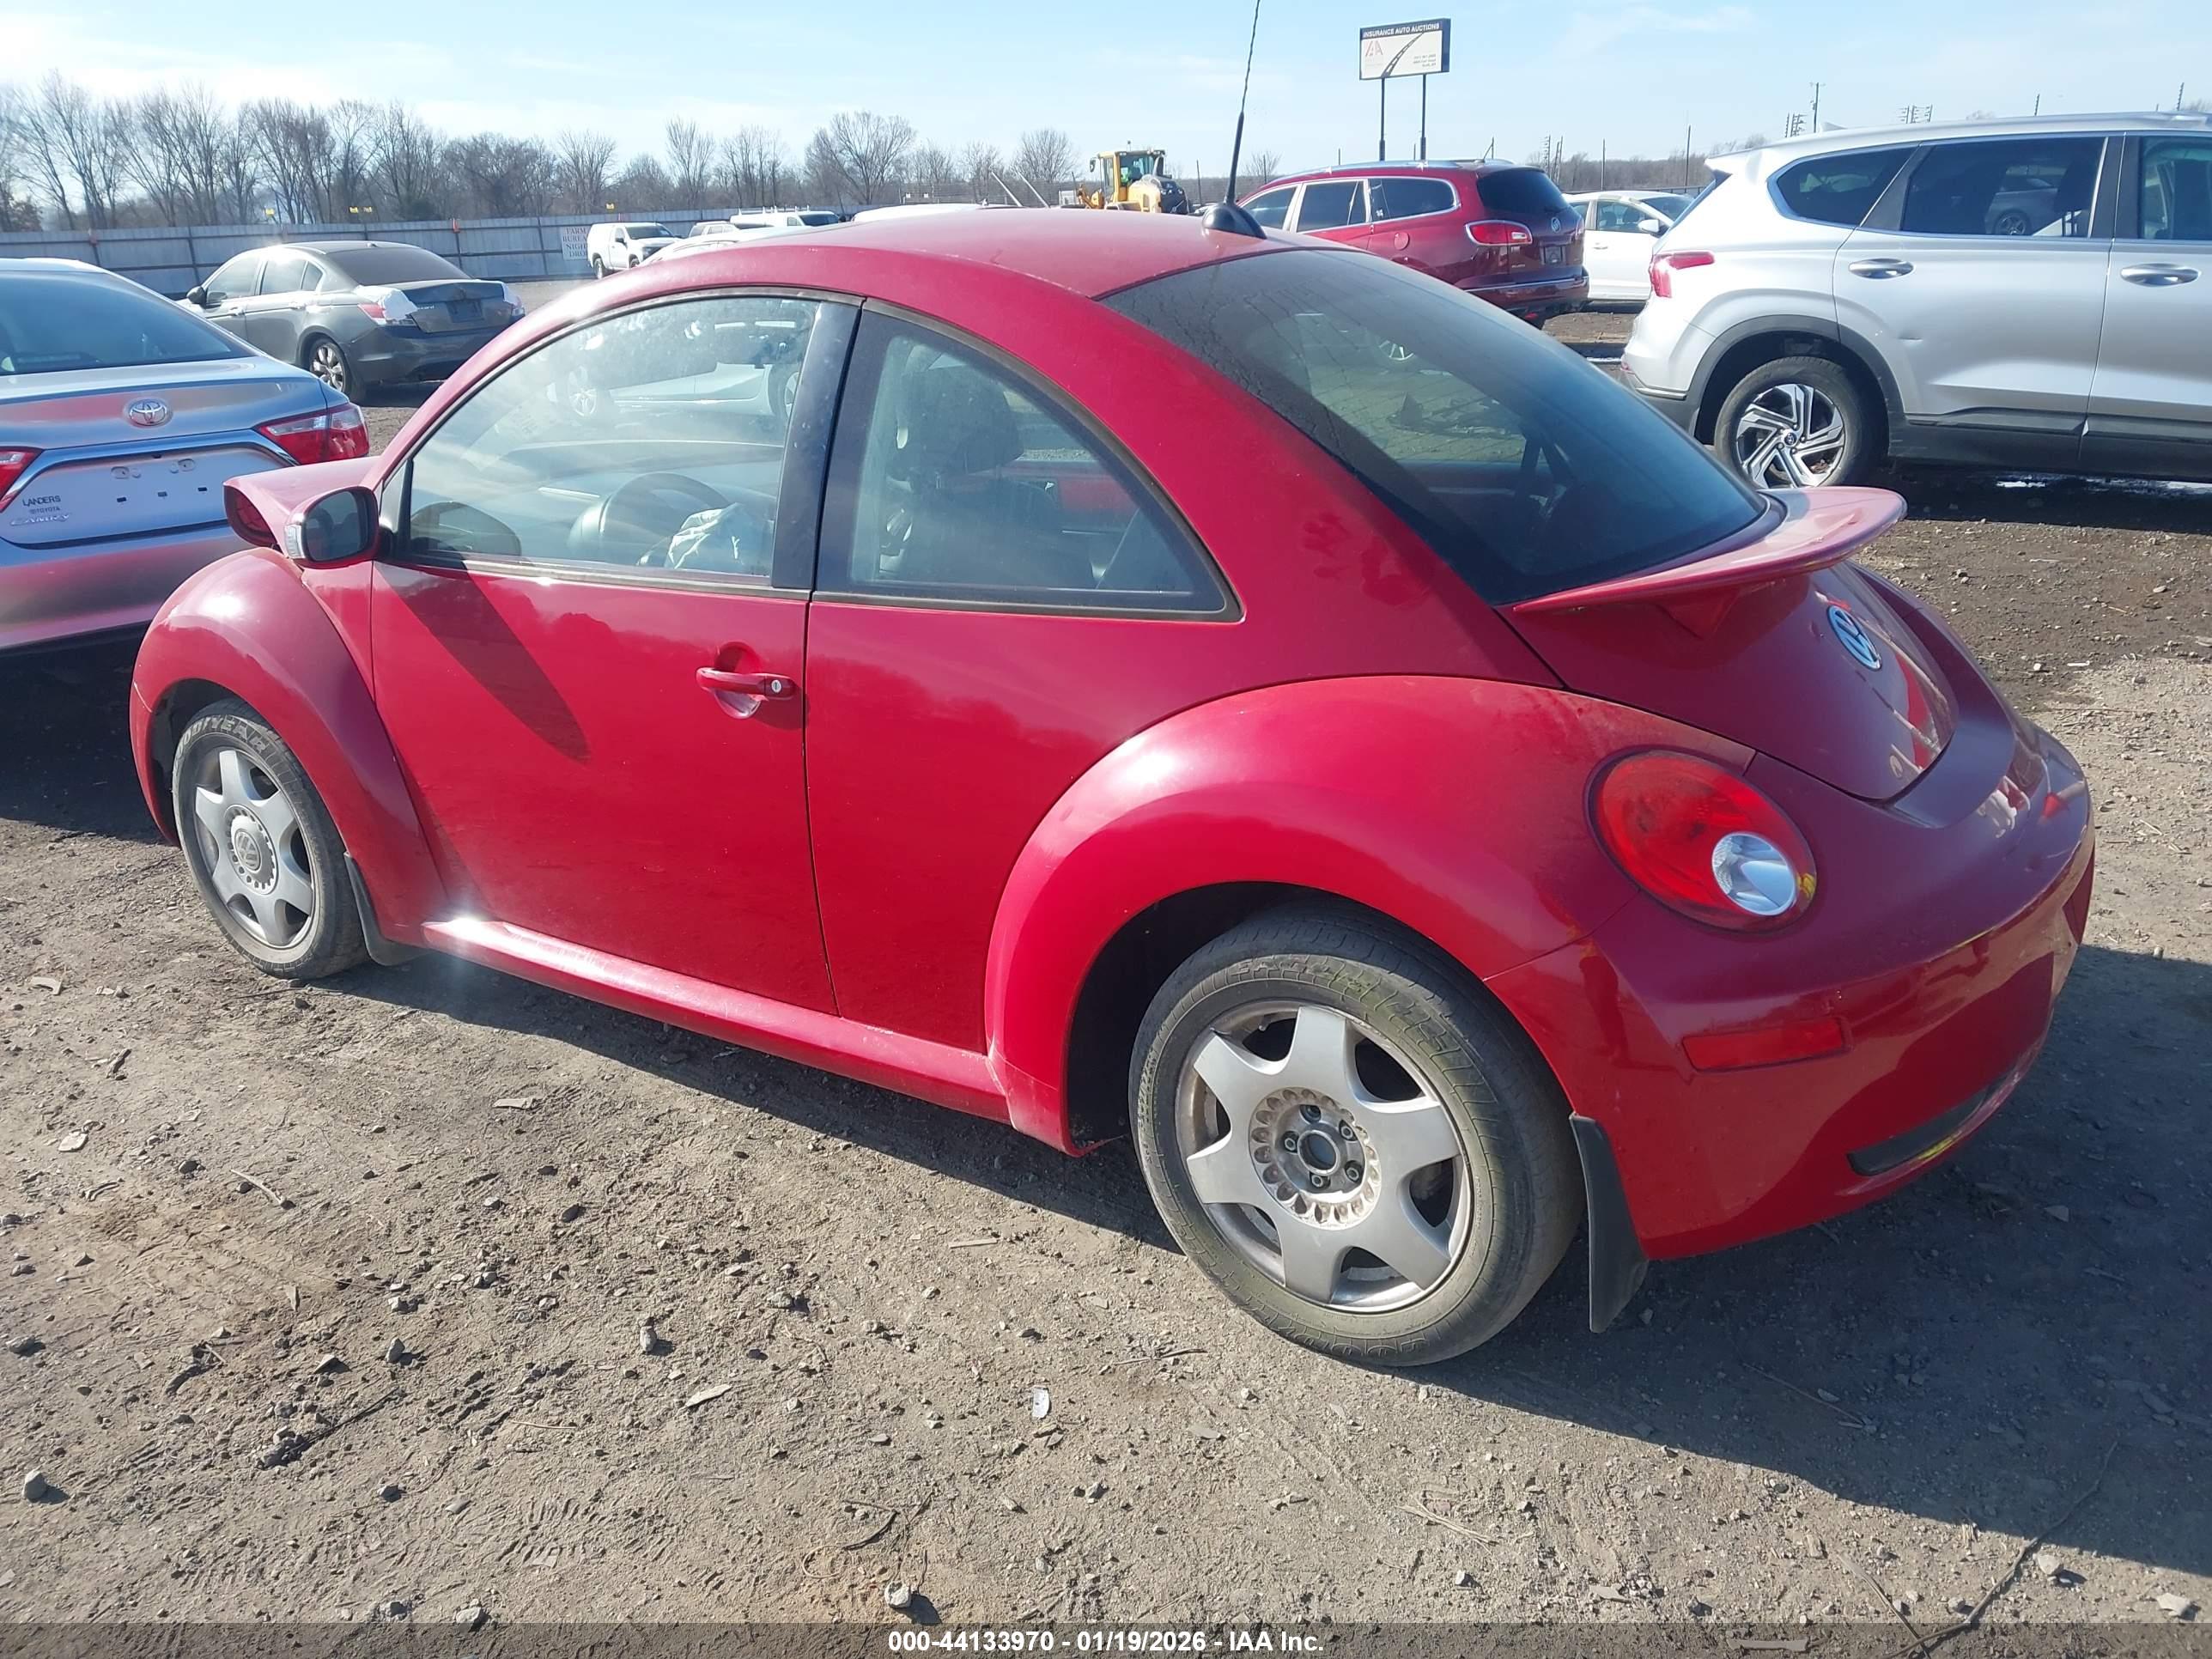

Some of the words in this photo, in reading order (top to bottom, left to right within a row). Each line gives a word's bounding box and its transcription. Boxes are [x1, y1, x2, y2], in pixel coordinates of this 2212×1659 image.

[1363, 28, 1395, 38] INSURANCE
[1411, 22, 1440, 32] AUCTIONS
[22, 495, 61, 507] LANDERS
